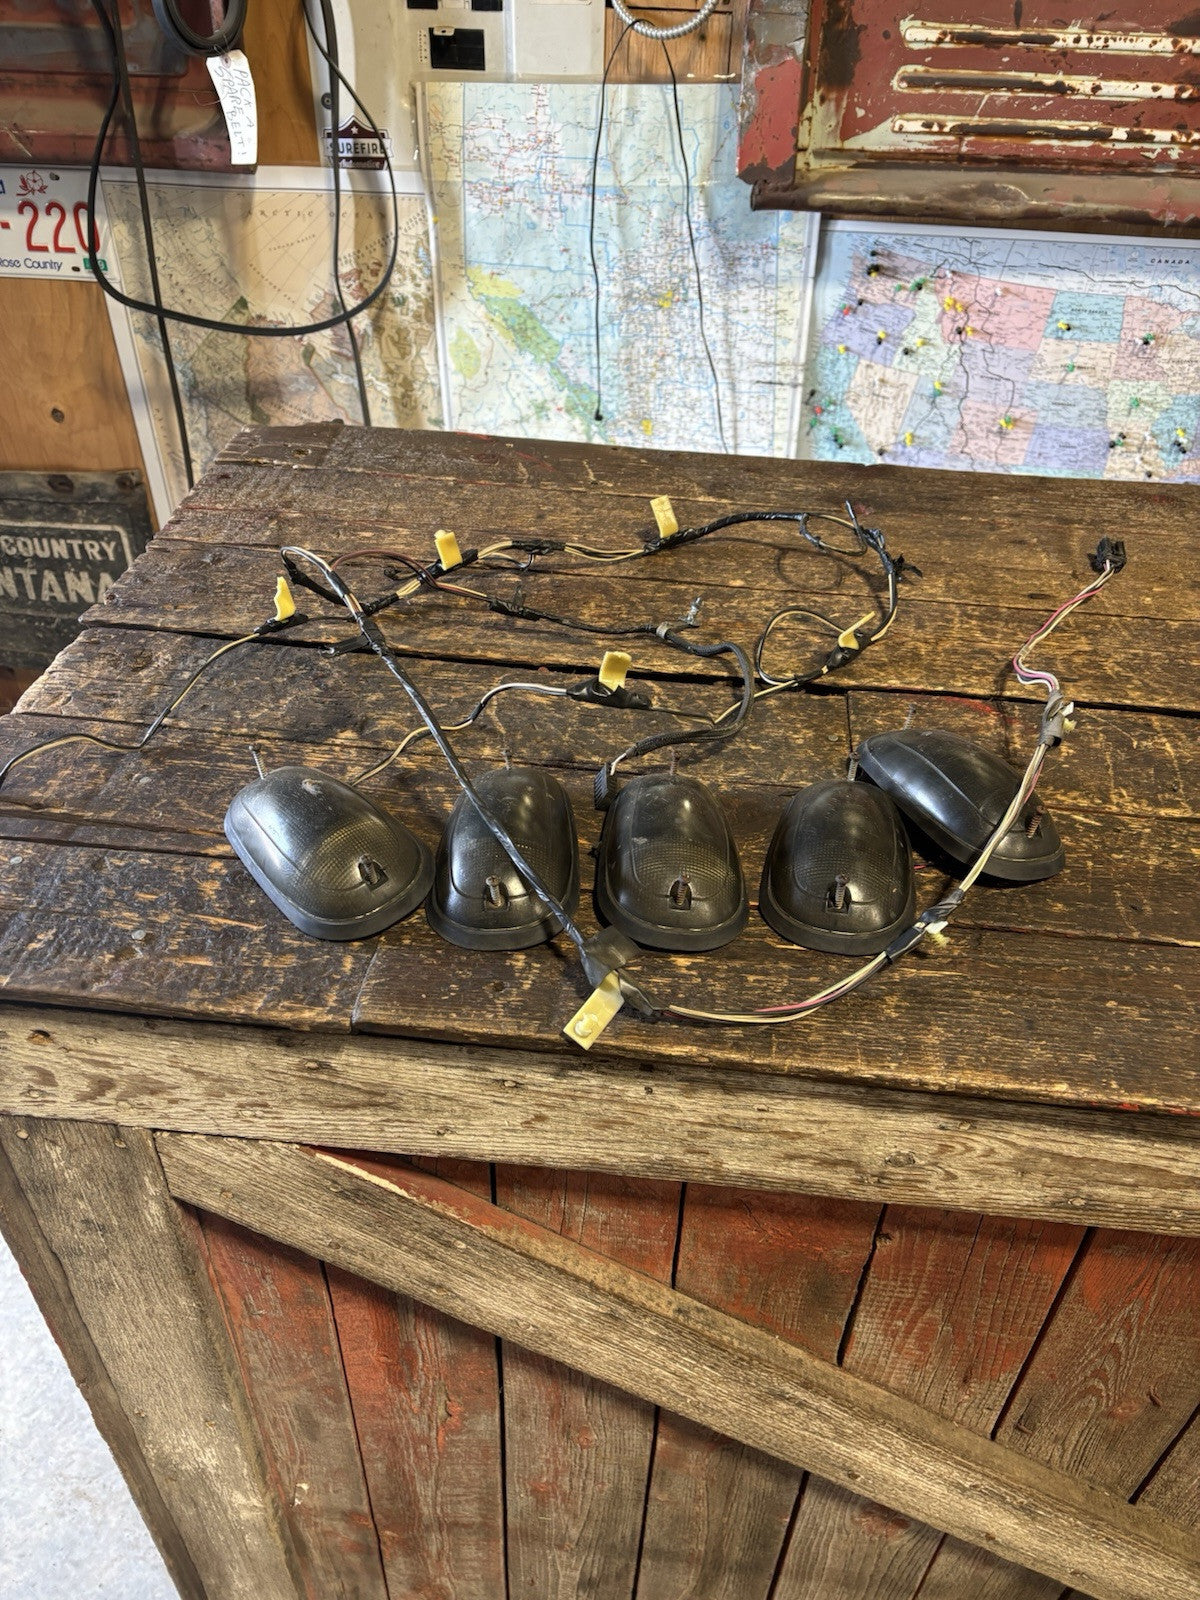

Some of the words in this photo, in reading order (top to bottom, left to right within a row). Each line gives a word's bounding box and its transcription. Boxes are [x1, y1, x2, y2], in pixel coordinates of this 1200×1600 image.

[233, 68, 252, 108] PACK
[23, 257, 63, 272] Country
[0, 535, 116, 561] COUNTRY
